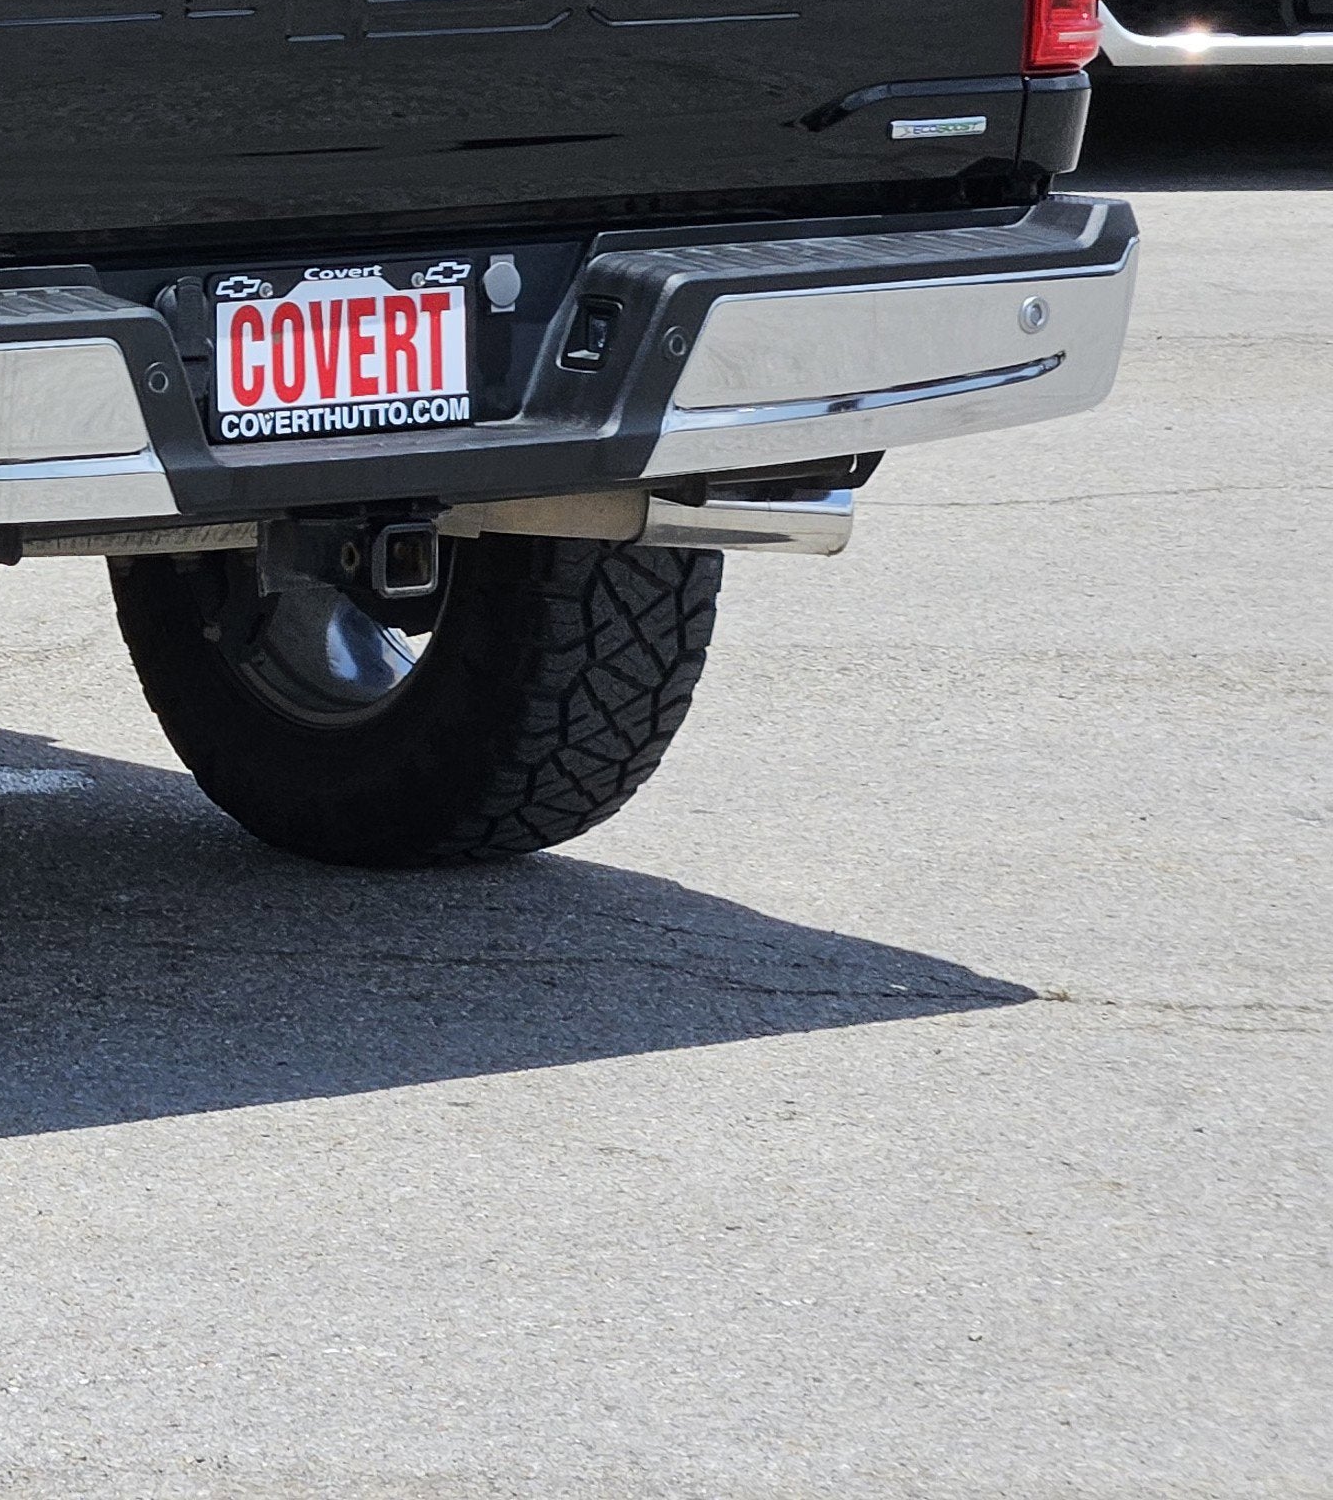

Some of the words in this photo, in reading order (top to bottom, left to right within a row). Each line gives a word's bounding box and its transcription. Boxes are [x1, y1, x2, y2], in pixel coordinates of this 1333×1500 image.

[303, 265, 383, 281] Covert
[230, 292, 451, 408] COVERT
[221, 396, 470, 439] COVERTHUTTO.COM
